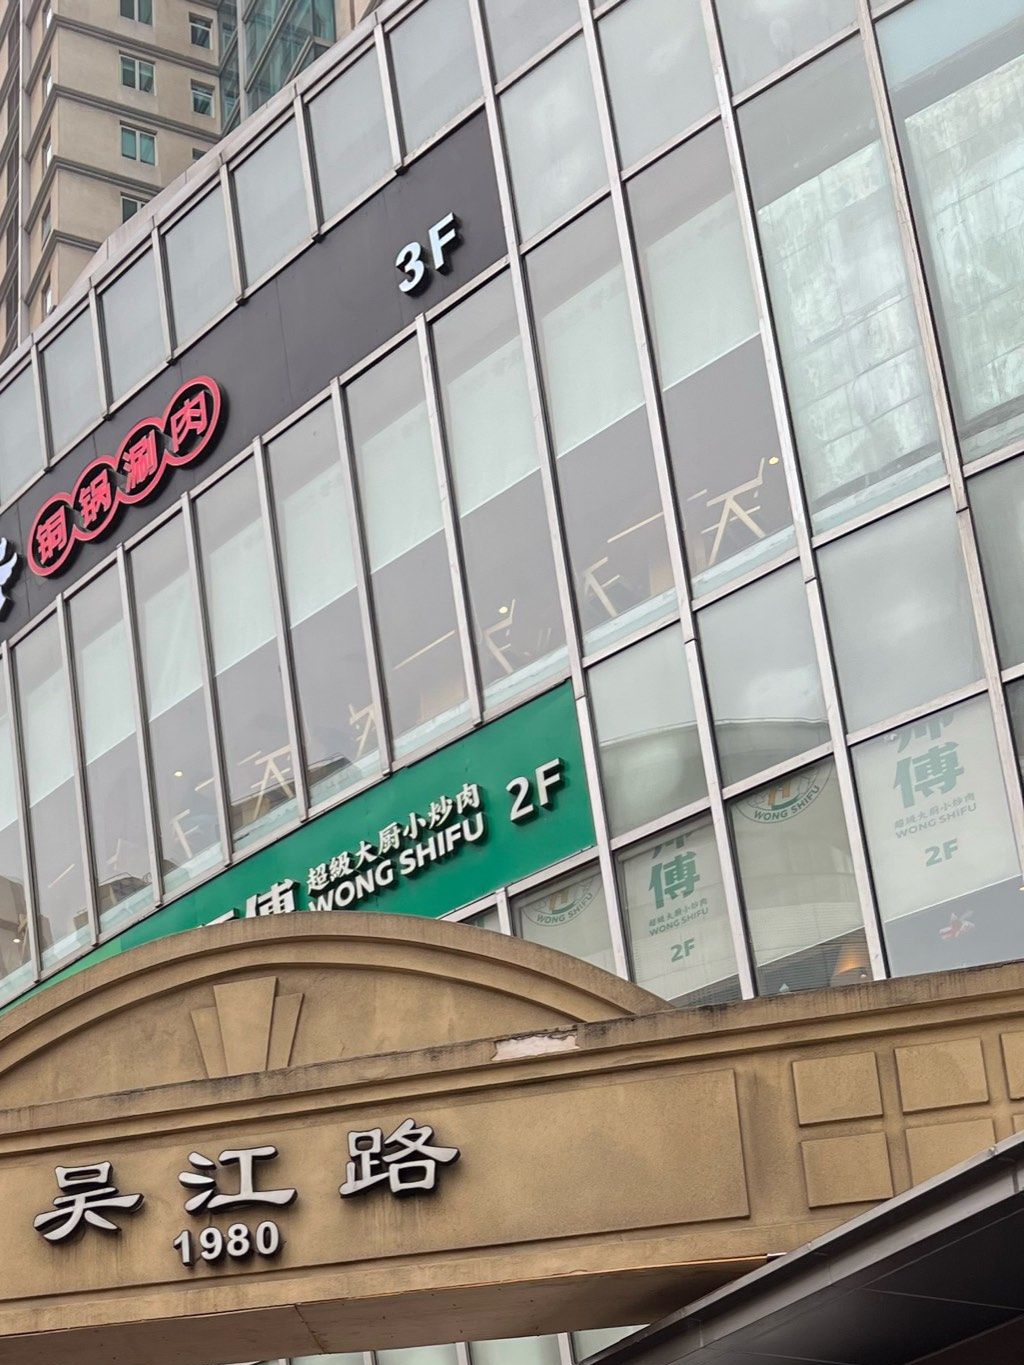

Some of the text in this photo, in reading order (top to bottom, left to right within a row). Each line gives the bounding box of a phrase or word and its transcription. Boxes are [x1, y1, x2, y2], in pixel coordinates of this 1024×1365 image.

[395, 213, 462, 293] 3F
[36, 390, 208, 565] 铜锅涮肉
[506, 757, 564, 823] 2F
[754, 785, 820, 821] WONG SHIFU
[895, 803, 977, 839] WONG SHIFU
[308, 813, 486, 912] WONG SHIFU
[648, 831, 700, 910] 傅
[925, 839, 958, 867] 2F
[536, 913, 566, 924] WONG
[649, 907, 709, 937] WONG SHIFU
[670, 938, 695, 963] 2F
[33, 1118, 461, 1243] 吴江路
[173, 1220, 282, 1267] 1980
